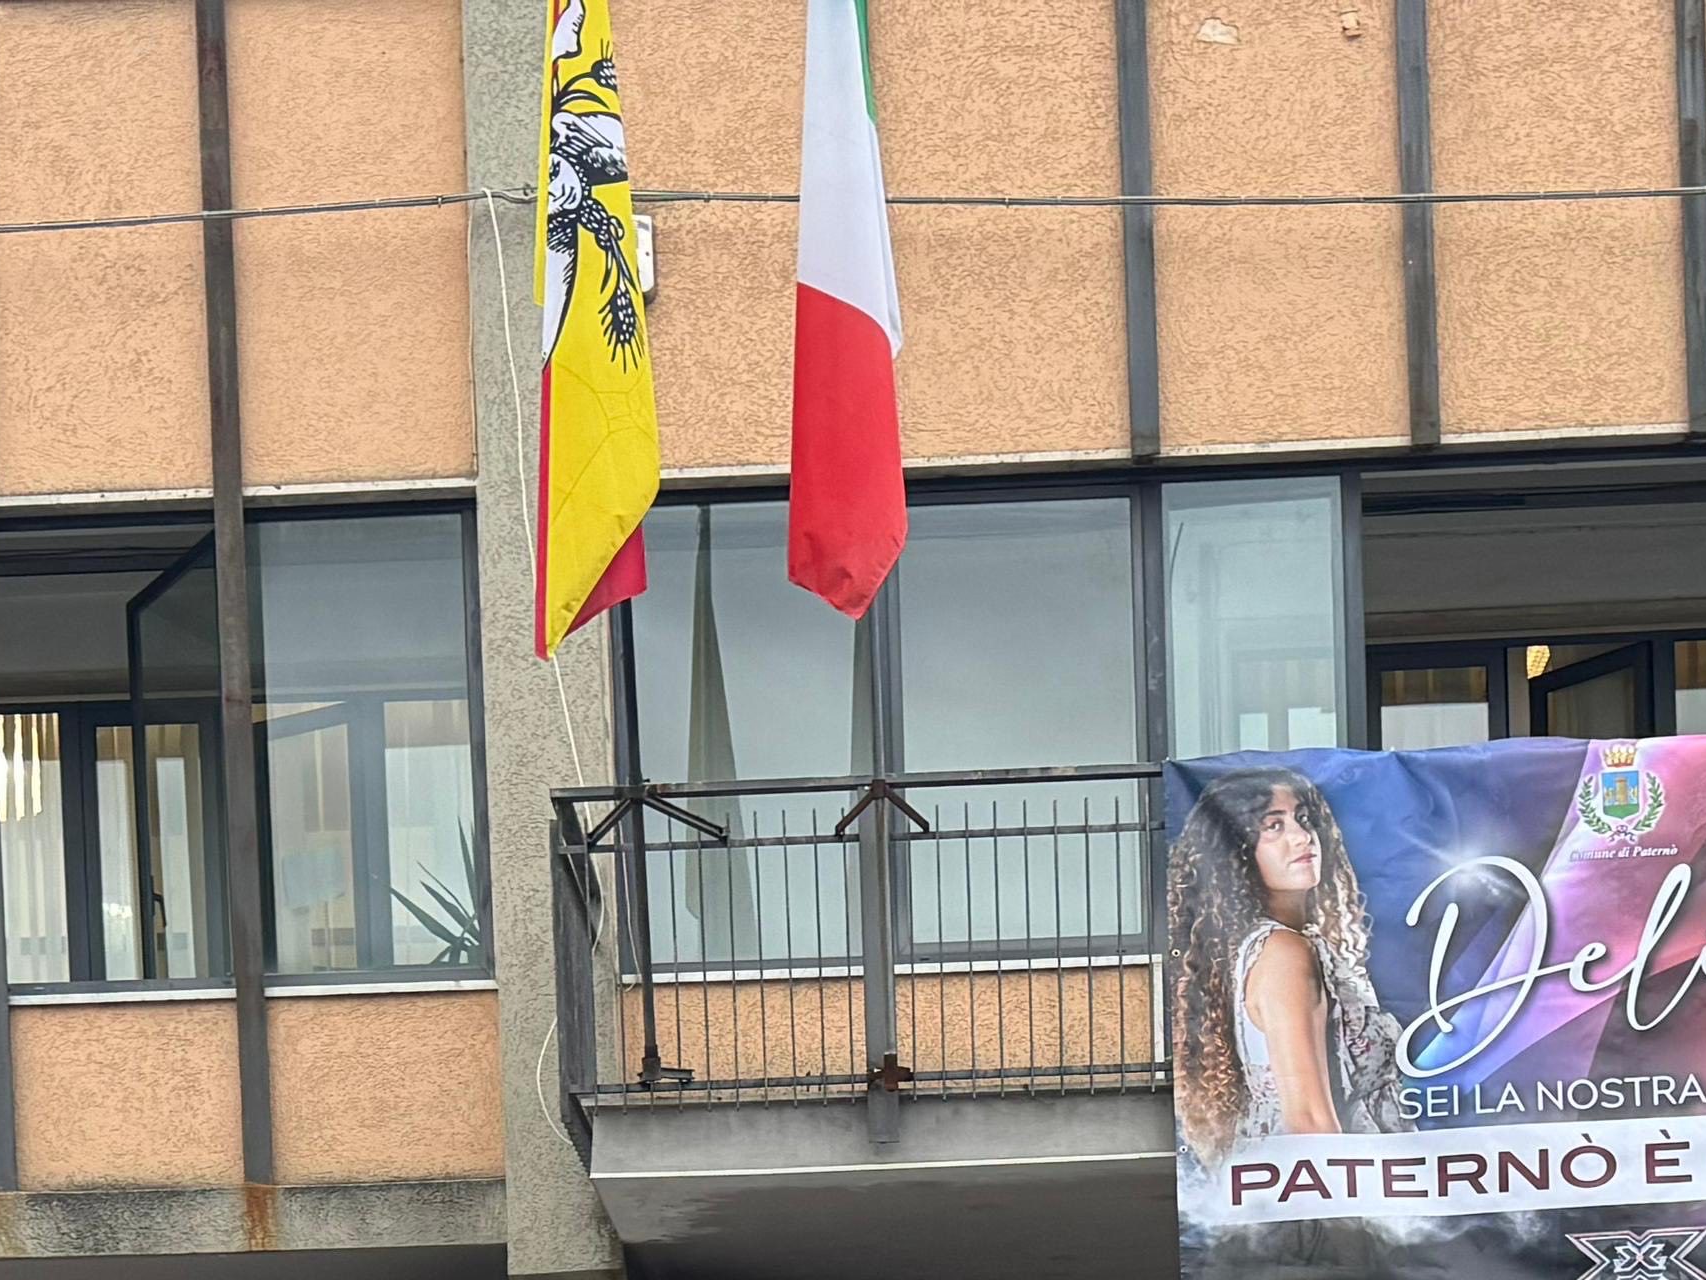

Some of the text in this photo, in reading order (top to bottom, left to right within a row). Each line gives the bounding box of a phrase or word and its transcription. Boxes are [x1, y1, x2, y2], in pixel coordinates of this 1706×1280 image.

[1618, 847, 1629, 858] di
[1633, 844, 1678, 857] Paternò
[1399, 1085, 1458, 1120] SEI
[1475, 1082, 1525, 1114] LA
[1537, 1075, 1706, 1111] NOSTRA
[1229, 1133, 1617, 1206] PATERNÒ
[1645, 1129, 1693, 1184] È
